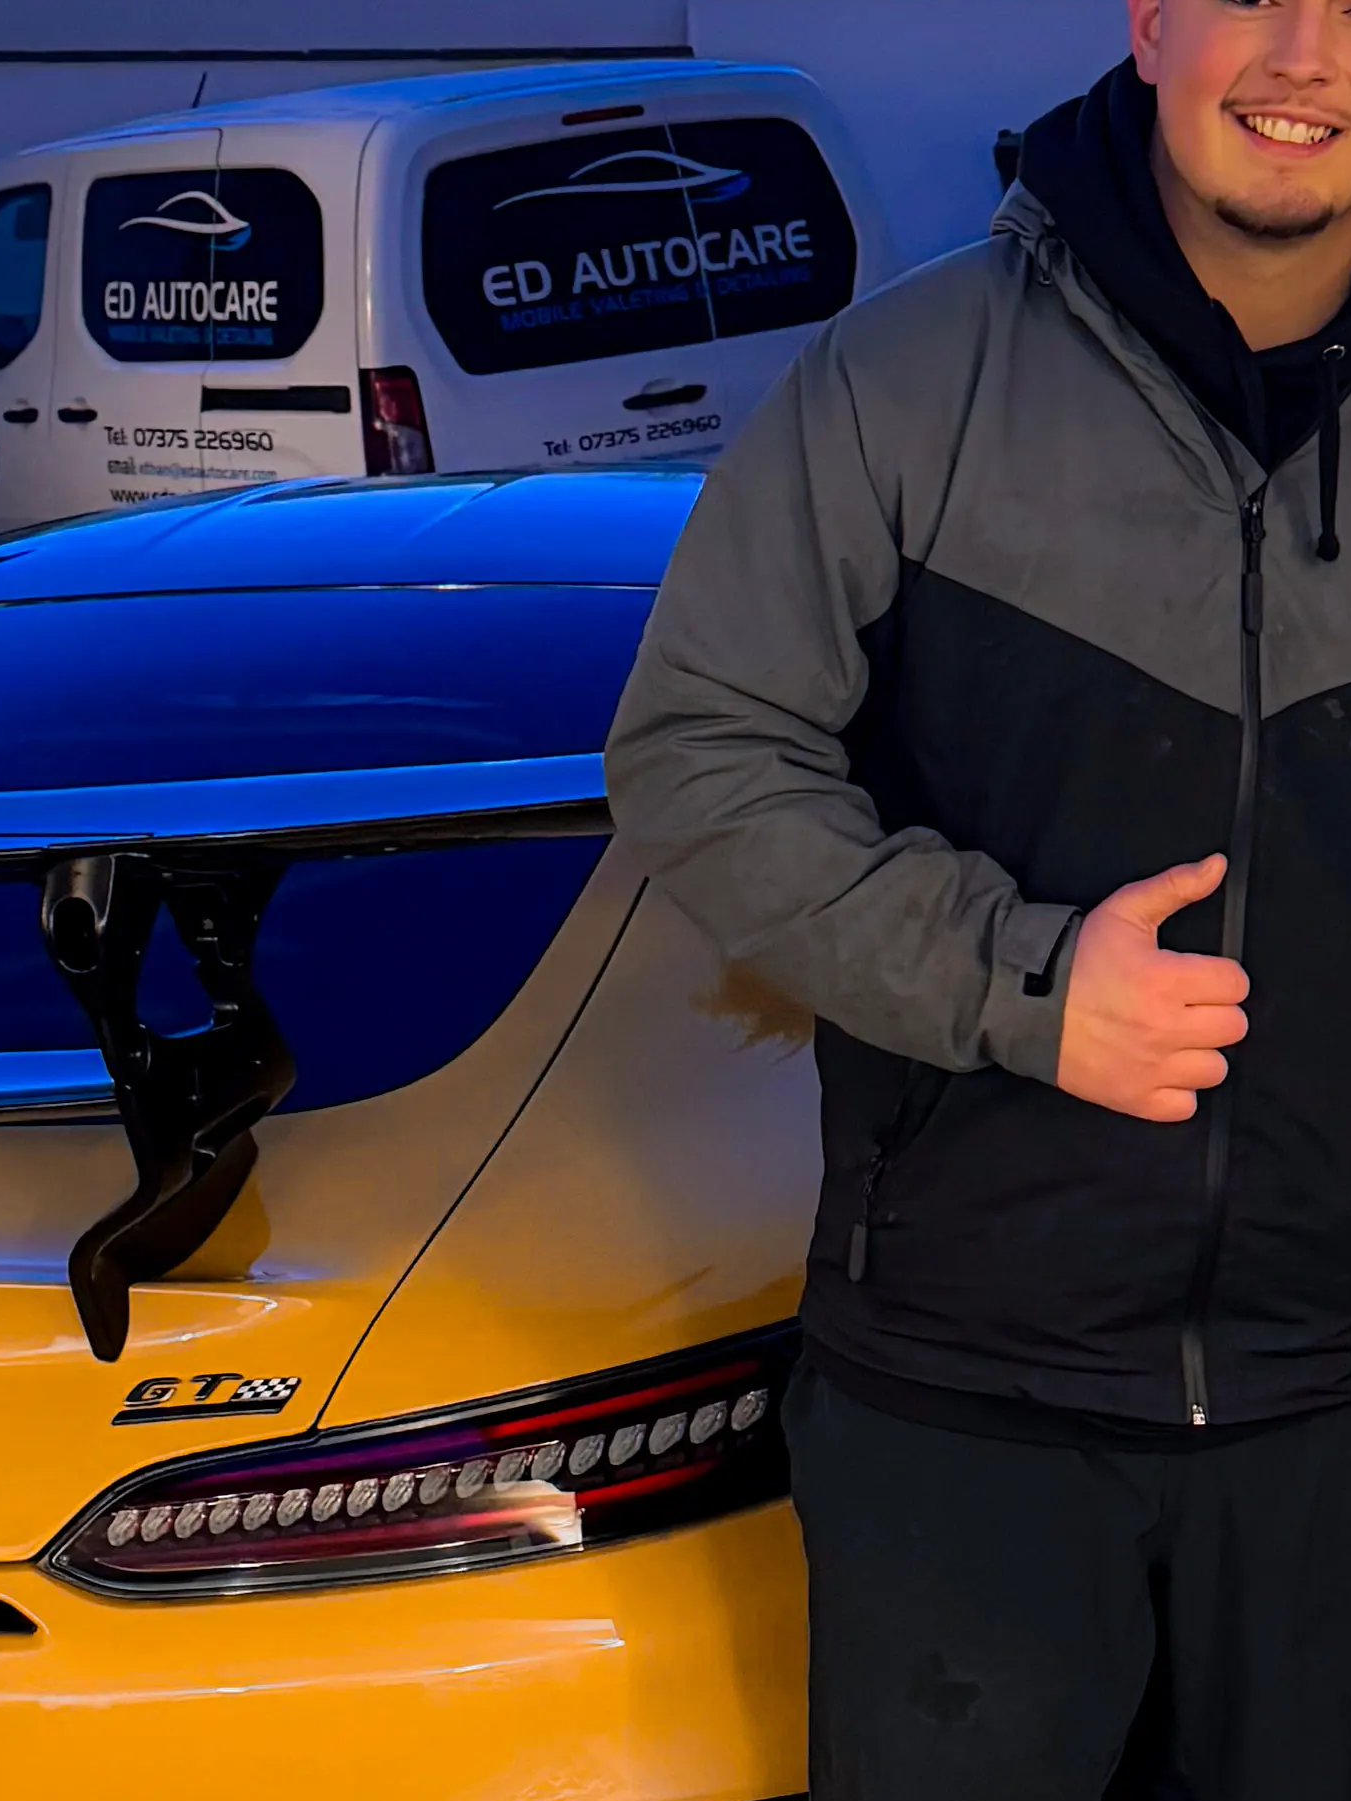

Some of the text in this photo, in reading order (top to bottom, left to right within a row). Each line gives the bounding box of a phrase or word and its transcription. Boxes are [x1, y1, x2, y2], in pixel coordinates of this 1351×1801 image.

[482, 219, 814, 307] ED AUTOCARE
[104, 280, 278, 322] ED AUTOCARE
[134, 428, 189, 448] 07375
[194, 429, 274, 451] 226960
[579, 427, 639, 451] 07375
[646, 414, 722, 441] 226960
